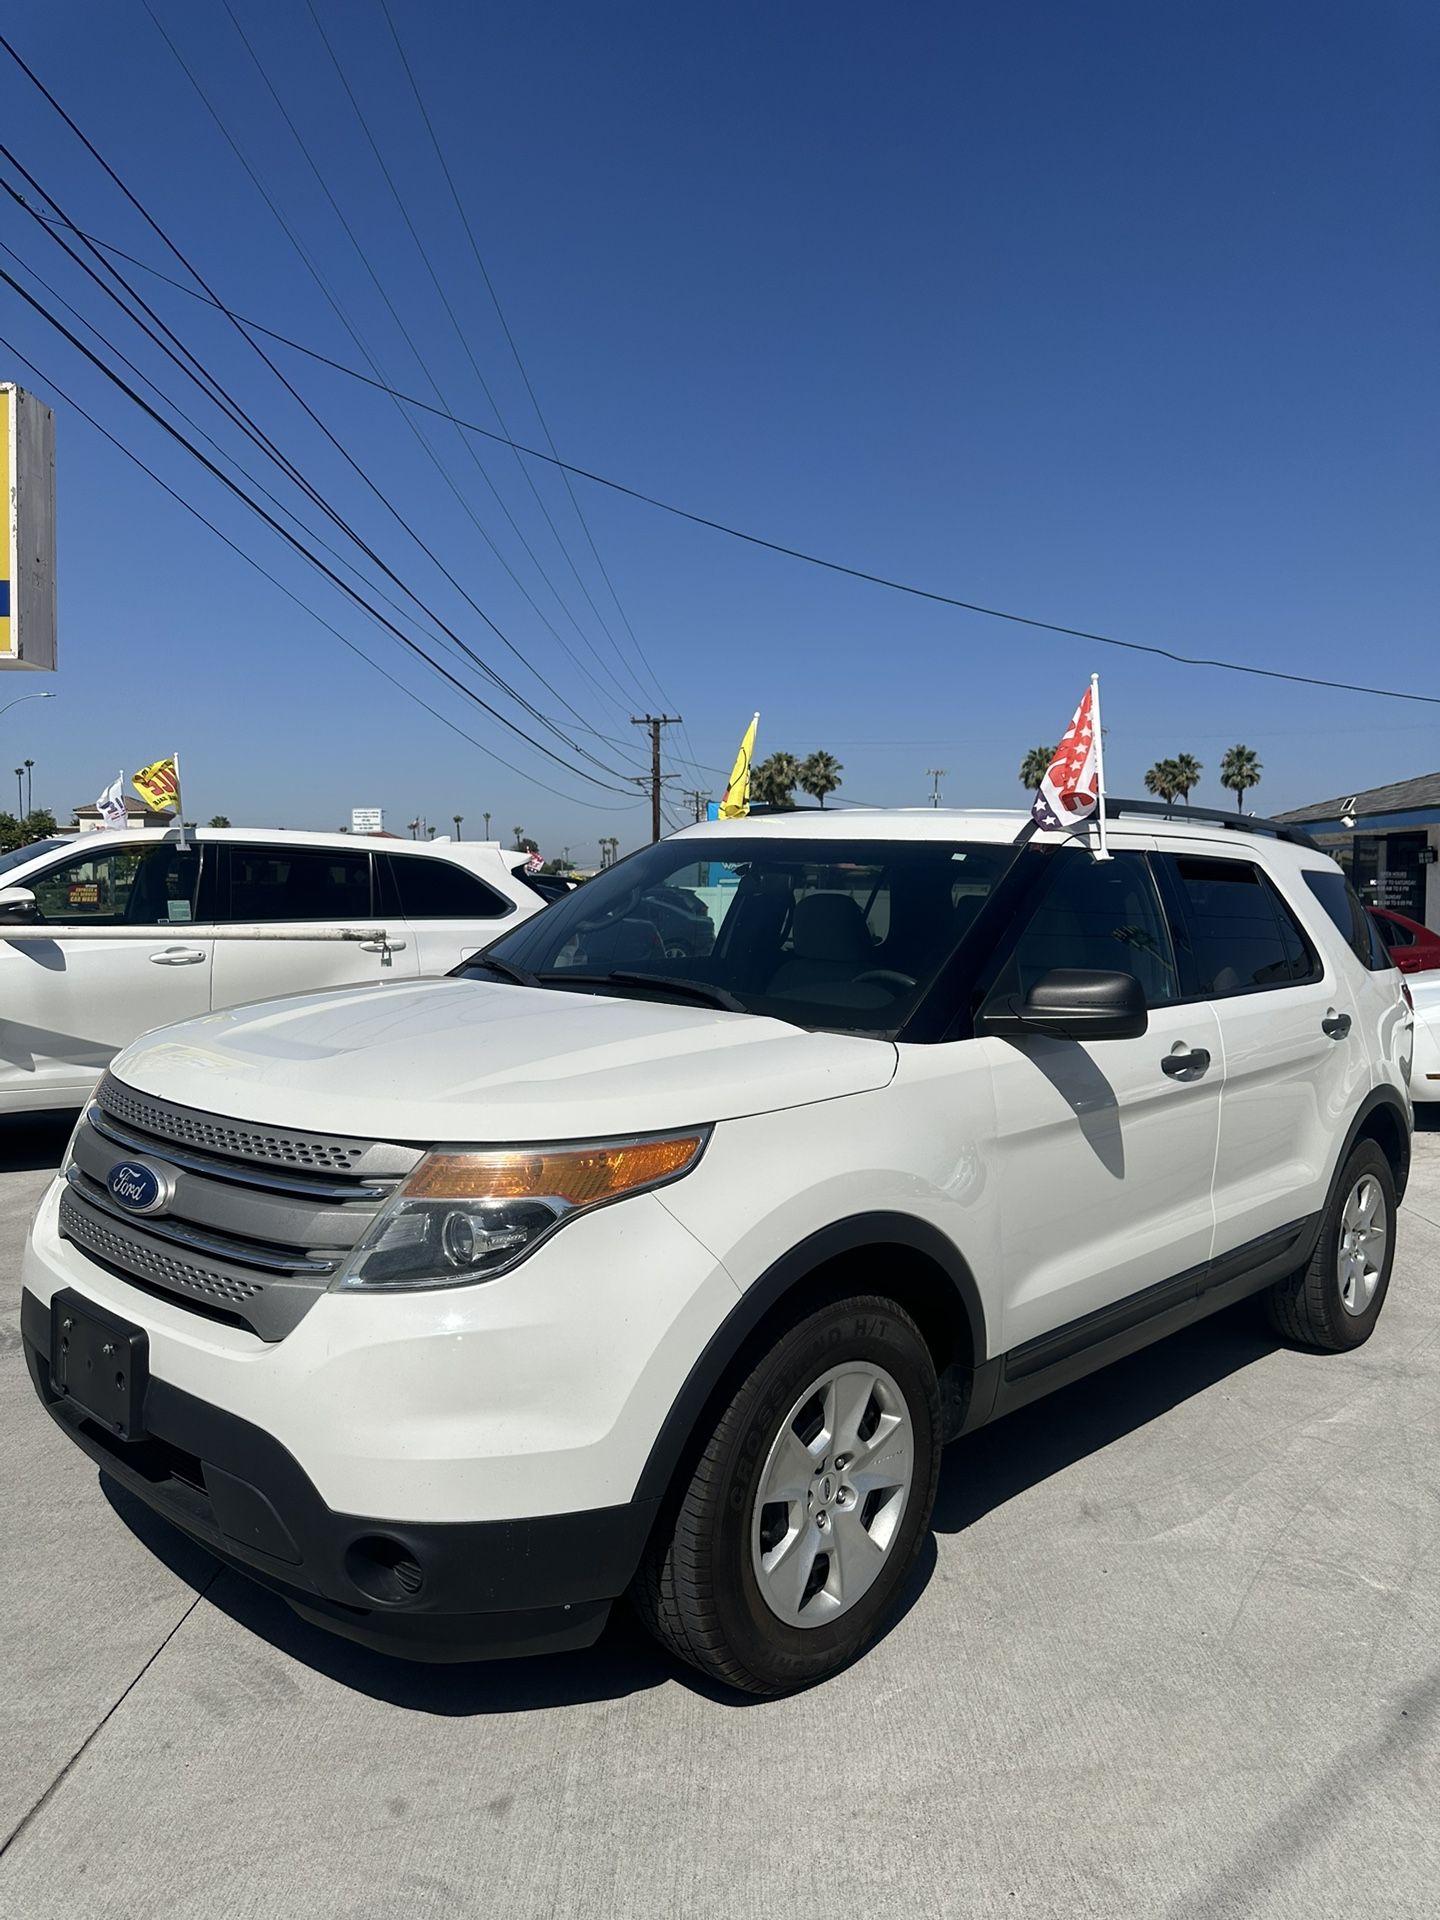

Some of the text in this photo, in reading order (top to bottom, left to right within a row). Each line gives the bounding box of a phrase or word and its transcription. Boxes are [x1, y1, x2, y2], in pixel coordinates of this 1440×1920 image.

[113, 1167, 147, 1201] Ford
[730, 1318, 889, 1511] CROSSND H/T
